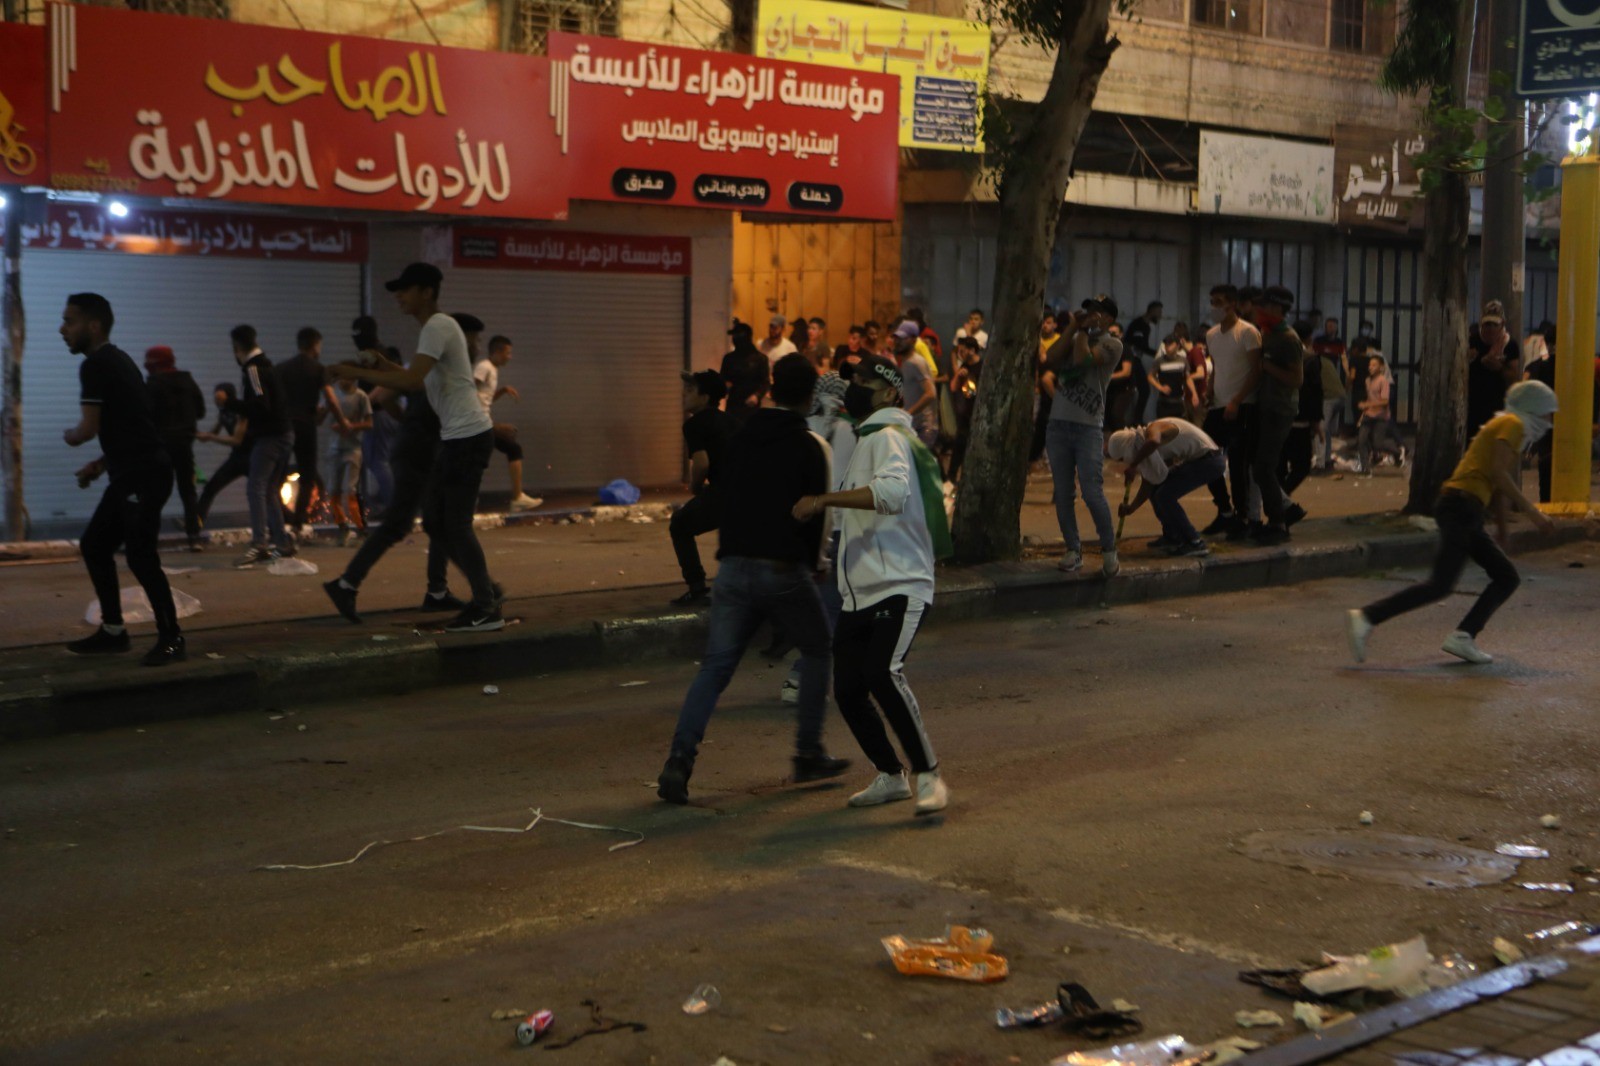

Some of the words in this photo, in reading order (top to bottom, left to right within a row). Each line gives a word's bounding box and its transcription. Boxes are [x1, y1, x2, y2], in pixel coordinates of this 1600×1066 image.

[766, 13, 849, 59] التجاري
[936, 29, 985, 71] سوق
[206, 41, 448, 121] الصاحب
[570, 44, 680, 96] للألبسة
[685, 62, 775, 110] الزهراء
[780, 68, 885, 121] مؤسسة
[622, 118, 698, 145] الملابس
[778, 128, 839, 167] إستيراد
[130, 110, 318, 198] المنزلية
[334, 129, 510, 209] للأدوات
[625, 173, 664, 192] مفرق
[800, 187, 832, 204] جملة
[260, 226, 352, 258] الصاحب
[504, 236, 564, 264] للألبسة
[567, 242, 617, 267] الزهراء
[620, 244, 682, 270] مؤسسة
